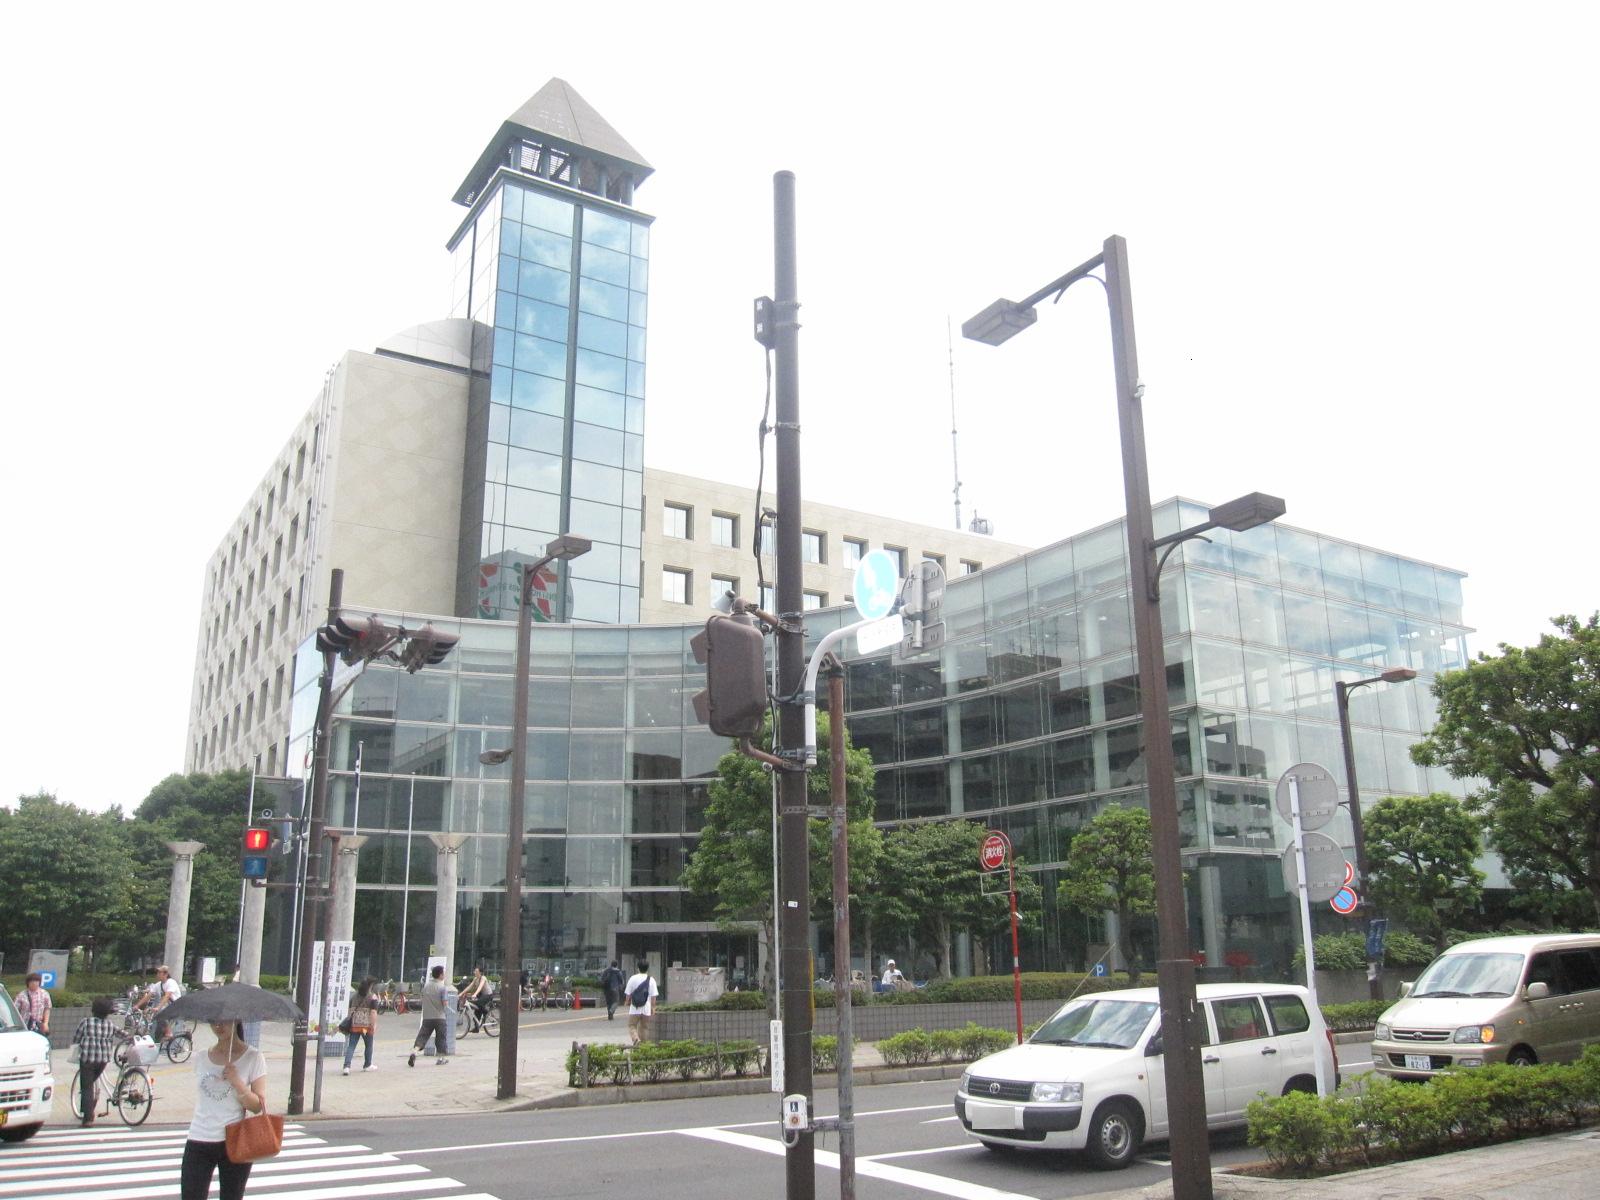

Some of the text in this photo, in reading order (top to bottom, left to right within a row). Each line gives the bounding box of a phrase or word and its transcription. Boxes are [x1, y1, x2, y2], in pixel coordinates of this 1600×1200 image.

[985, 845, 1003, 859] 消火栓
[1096, 964, 1104, 977] P
[40, 972, 53, 987] P
